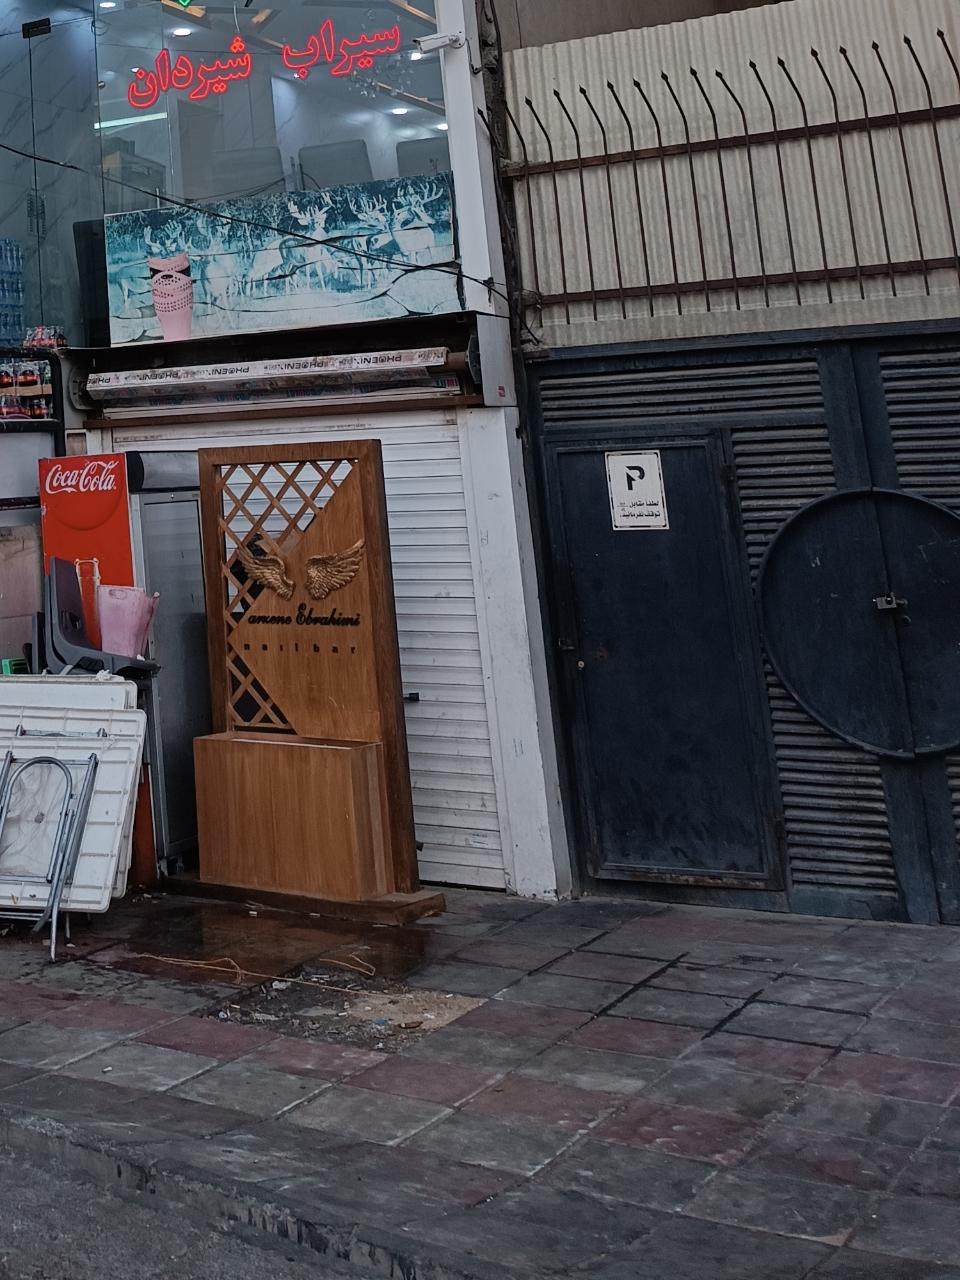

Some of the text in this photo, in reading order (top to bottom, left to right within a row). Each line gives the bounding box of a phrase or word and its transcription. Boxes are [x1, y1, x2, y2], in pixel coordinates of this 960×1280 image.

[127, 19, 401, 109] سیراب شیردان
[46, 460, 119, 494] Coca-Cola
[296, 603, 361, 627] Ebrahimi
